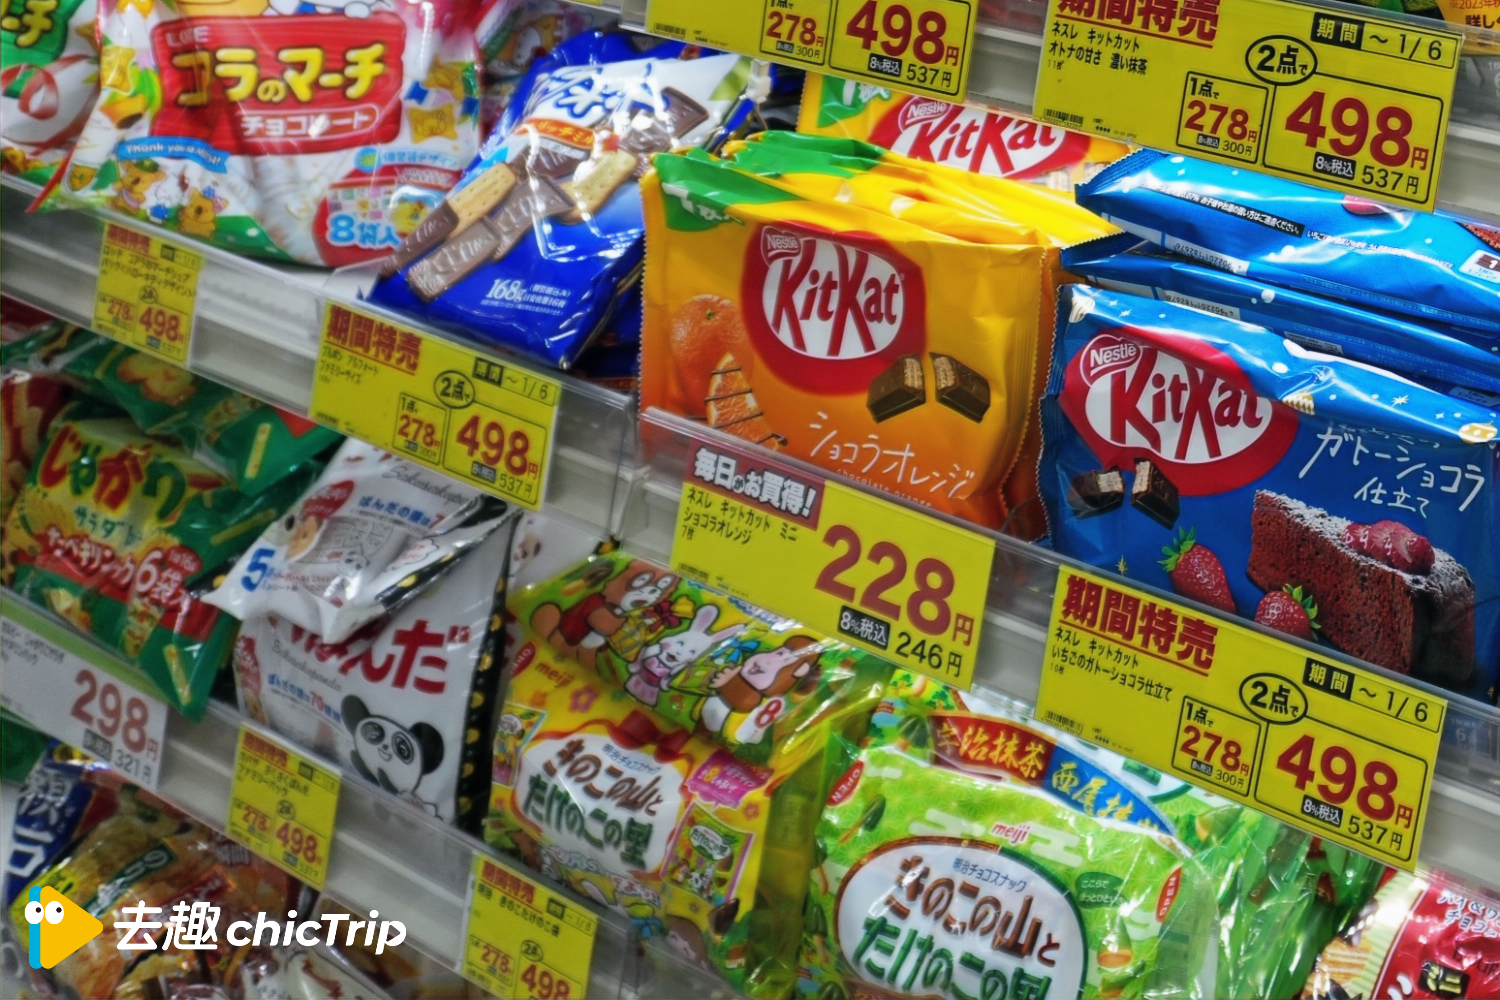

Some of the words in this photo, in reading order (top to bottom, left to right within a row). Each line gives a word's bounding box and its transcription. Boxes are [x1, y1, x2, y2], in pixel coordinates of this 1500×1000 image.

[1316, 17, 1359, 44] 期間
[766, 232, 799, 254] Nestlé
[771, 240, 900, 358] KitKat
[1088, 341, 1138, 369] Nestlé
[1109, 345, 1264, 462] KitKat
[1353, 476, 1432, 520] 仕立て
[1060, 574, 1218, 671] 期間特売
[1054, 626, 1081, 649] ネスレ
[1088, 636, 1140, 669] キットカット
[1308, 664, 1350, 693] 期間
